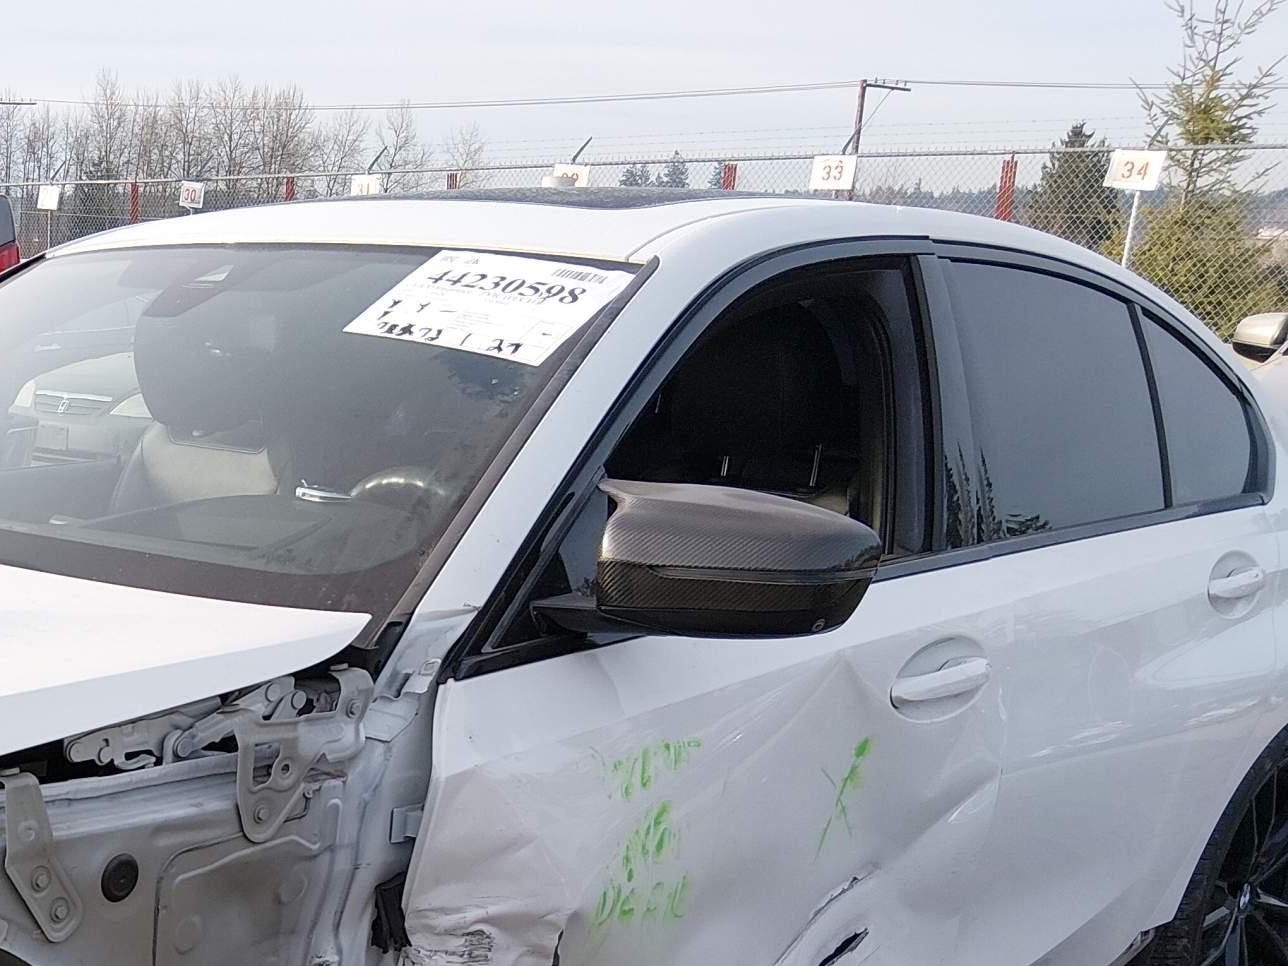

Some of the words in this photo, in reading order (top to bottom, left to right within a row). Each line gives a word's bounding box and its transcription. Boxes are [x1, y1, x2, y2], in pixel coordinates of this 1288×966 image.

[822, 164, 843, 181] 33
[1121, 160, 1149, 181] 34
[427, 269, 587, 304] 44230598
